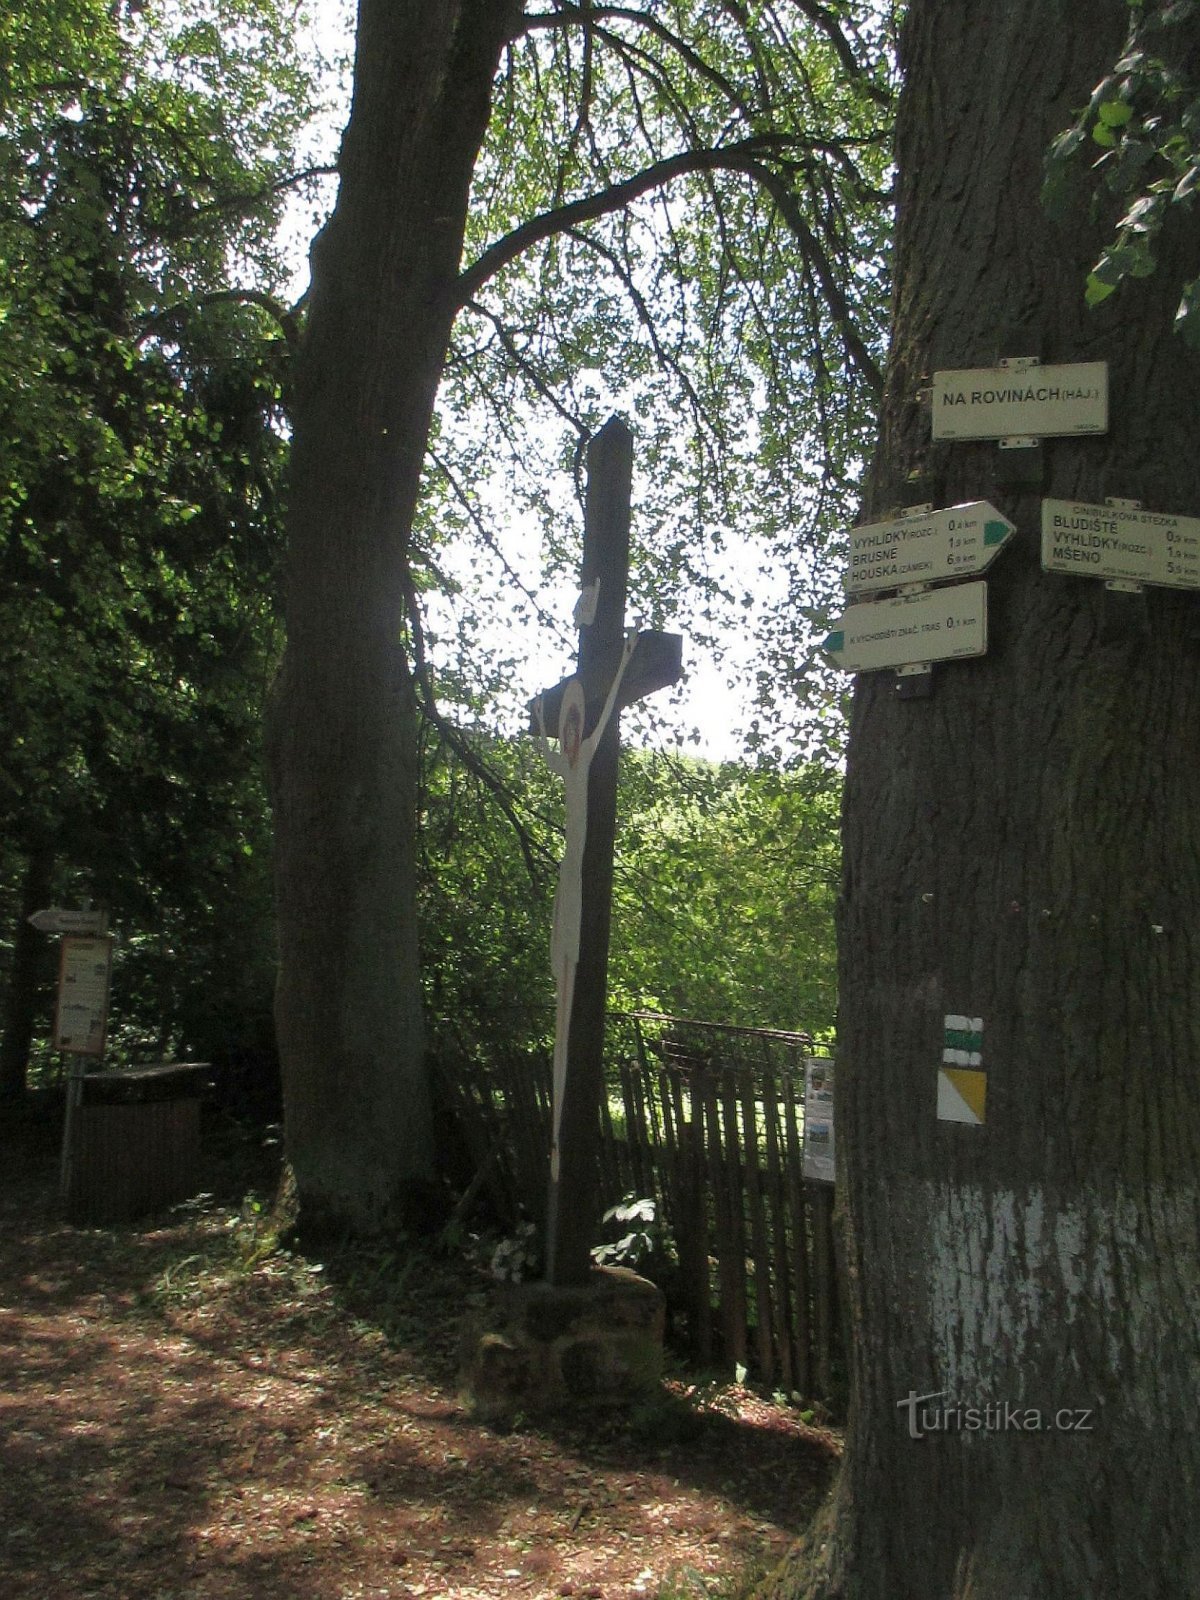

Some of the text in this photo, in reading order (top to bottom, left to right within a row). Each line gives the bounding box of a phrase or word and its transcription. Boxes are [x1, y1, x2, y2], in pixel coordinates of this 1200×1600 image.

[942, 392, 966, 406] NA
[971, 385, 1059, 404] ROVINÁCH
[965, 520, 978, 528] km
[1141, 515, 1178, 526] STEZKA
[963, 537, 976, 545] km
[1052, 546, 1100, 564] MŠENO
[852, 564, 898, 582] HOUSKA
[963, 618, 976, 626] km
